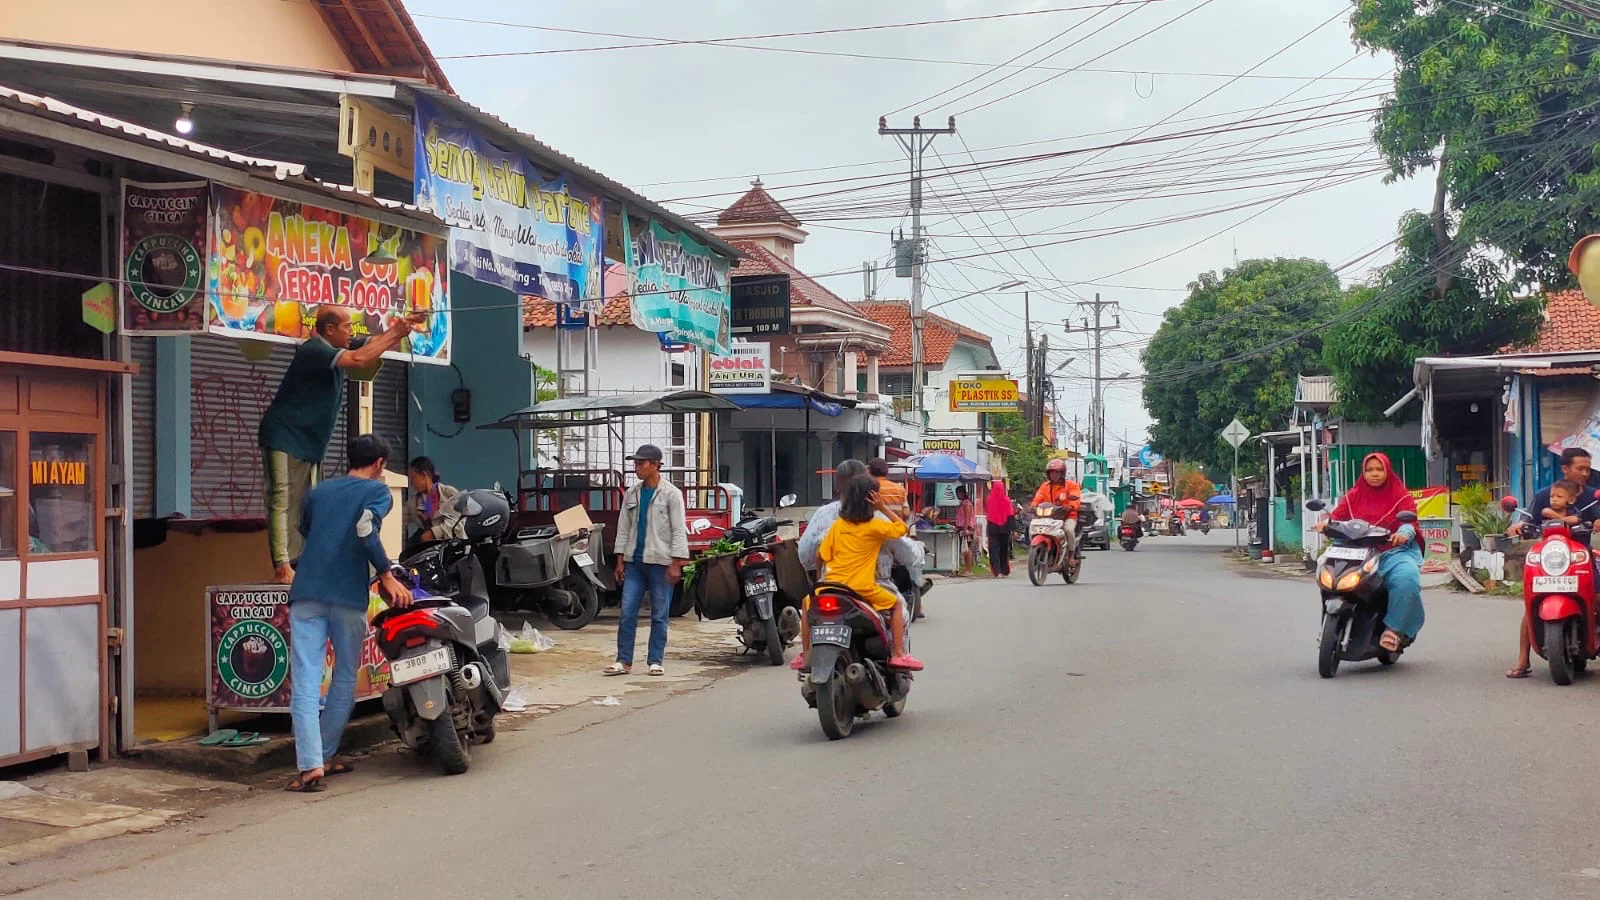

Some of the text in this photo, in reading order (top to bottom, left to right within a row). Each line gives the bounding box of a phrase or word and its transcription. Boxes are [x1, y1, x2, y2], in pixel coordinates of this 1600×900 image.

[267, 211, 353, 271] ANEKA
[278, 263, 335, 306] SERBA
[140, 291, 186, 310] CINCAU
[756, 323, 780, 332] 100 M
[710, 356, 765, 370] eblak
[924, 440, 960, 450] WONTON
[32, 460, 86, 485] MI AYAM
[216, 592, 289, 605] CAPPUCCINO
[231, 605, 275, 619] CINCAU
[223, 623, 282, 650] CAPPUCCINO
[230, 678, 276, 695] CINCAU
